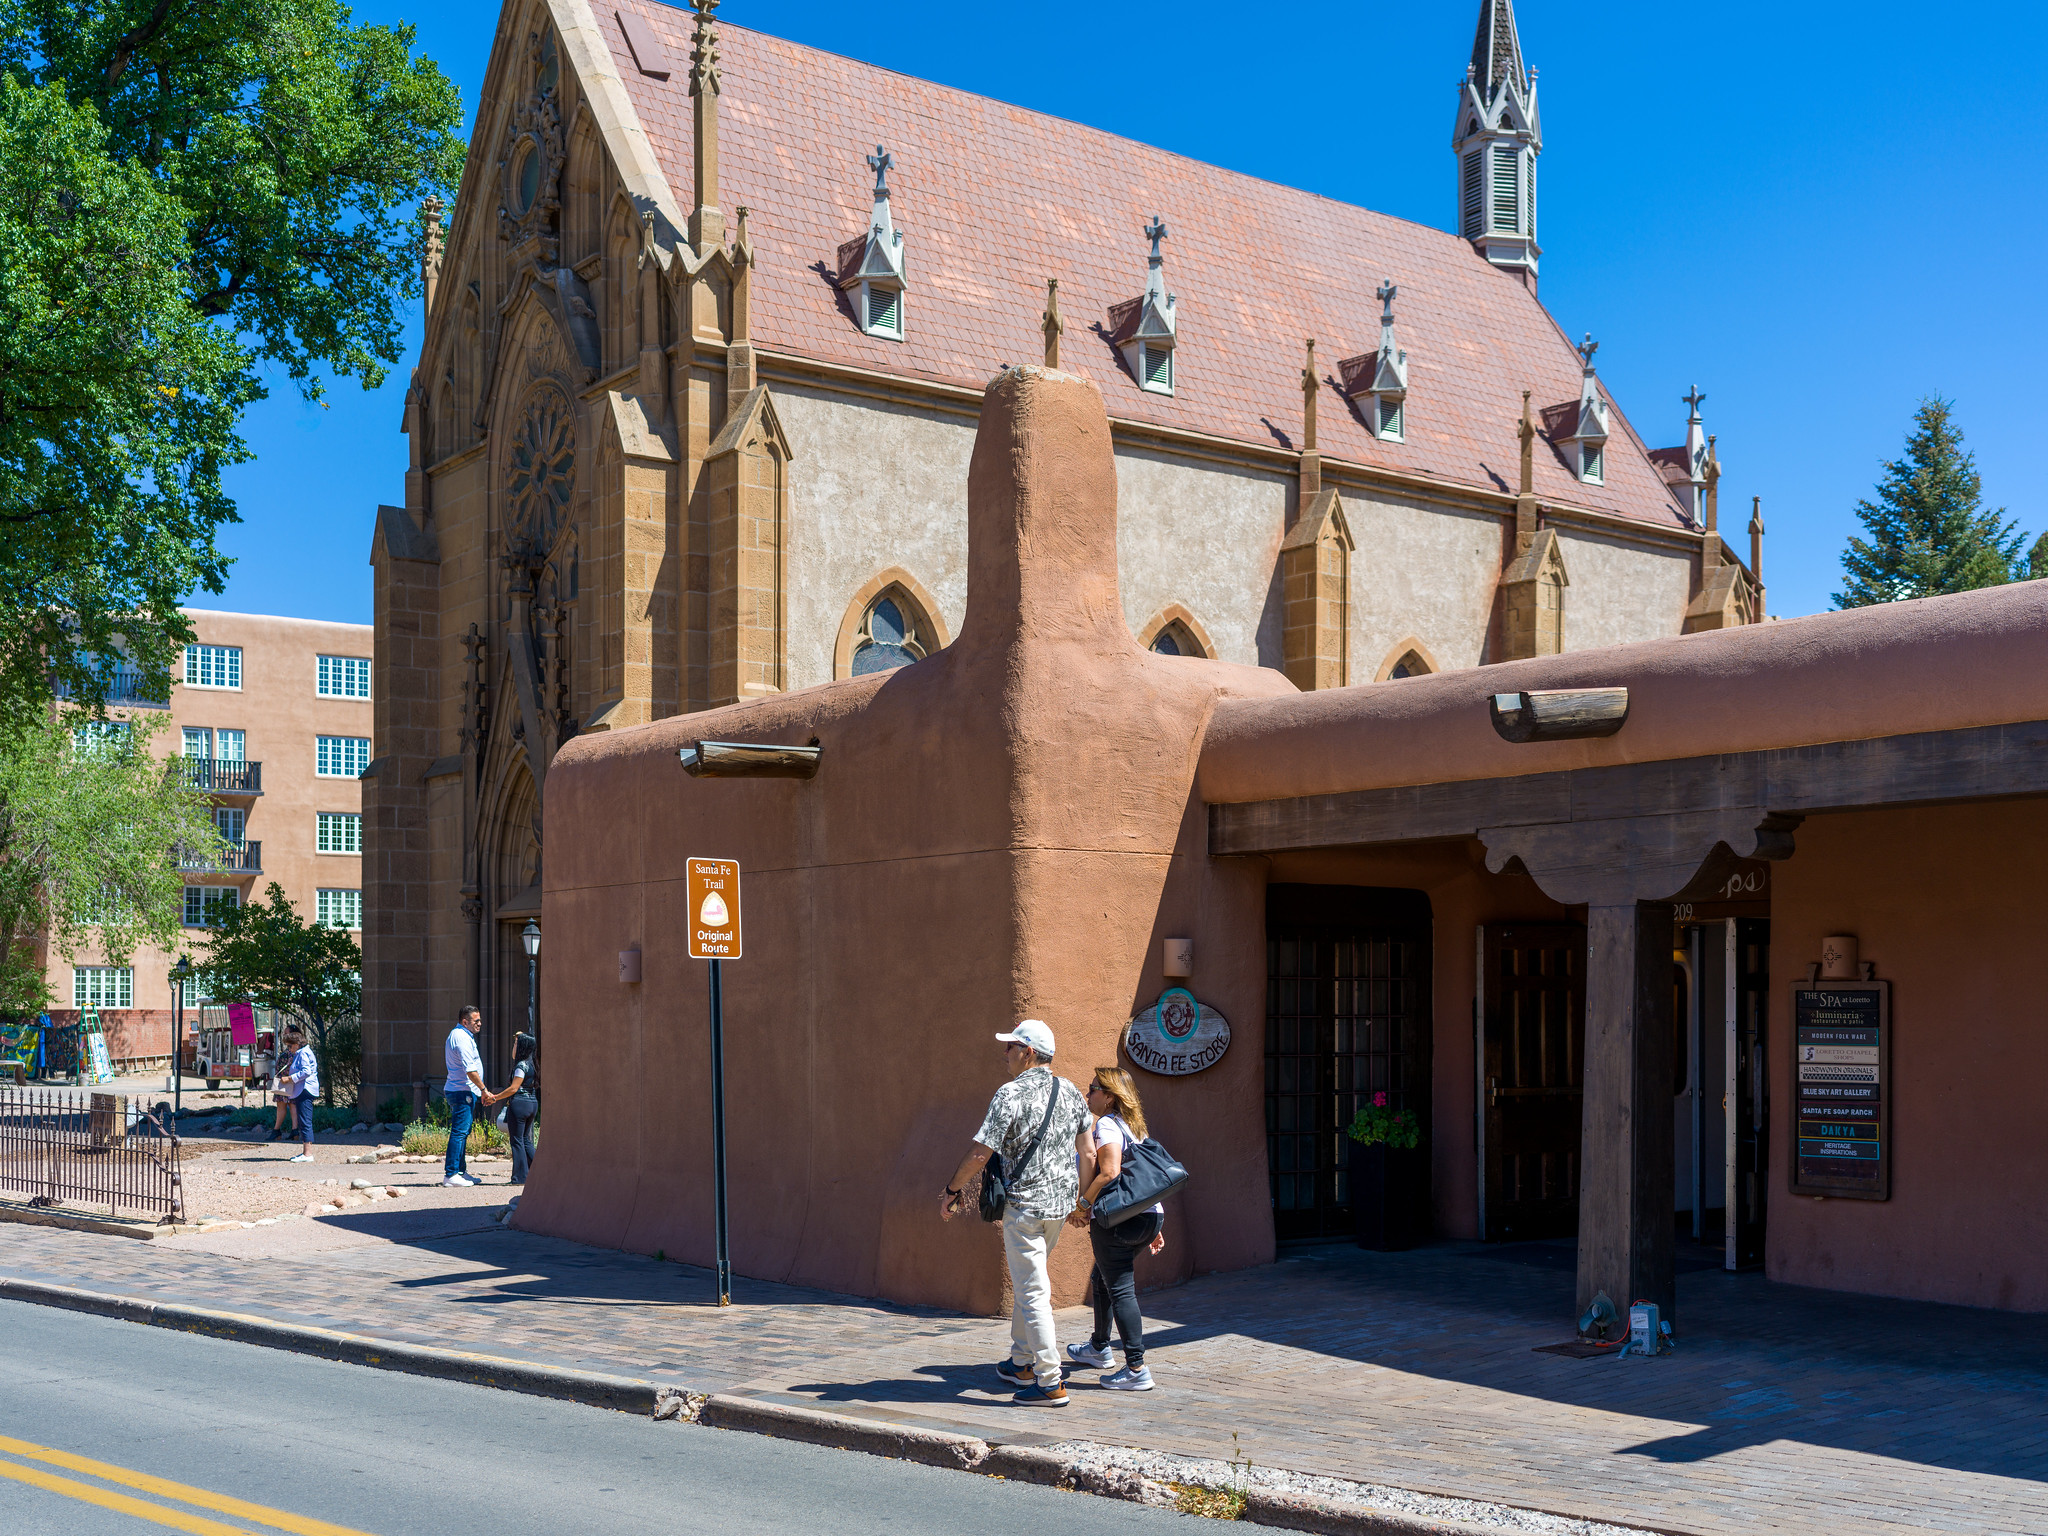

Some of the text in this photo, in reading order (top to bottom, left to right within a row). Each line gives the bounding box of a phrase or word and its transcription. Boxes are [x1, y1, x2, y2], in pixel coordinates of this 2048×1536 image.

[696, 864, 731, 875] Santa Fe
[704, 879, 724, 889] Trail
[697, 930, 733, 943] Original
[701, 943, 729, 953] Route
[1803, 992, 1818, 1000] THE
[1816, 1010, 1859, 1019] luminaria
[1128, 1031, 1229, 1071] SANTA FE STORE
[1803, 1066, 1842, 1074] HANDWOVEN
[1830, 1088, 1842, 1096] ART
[1821, 1125, 1855, 1137] DAKYA
[1820, 1149, 1857, 1157] INSPIRATIONS
